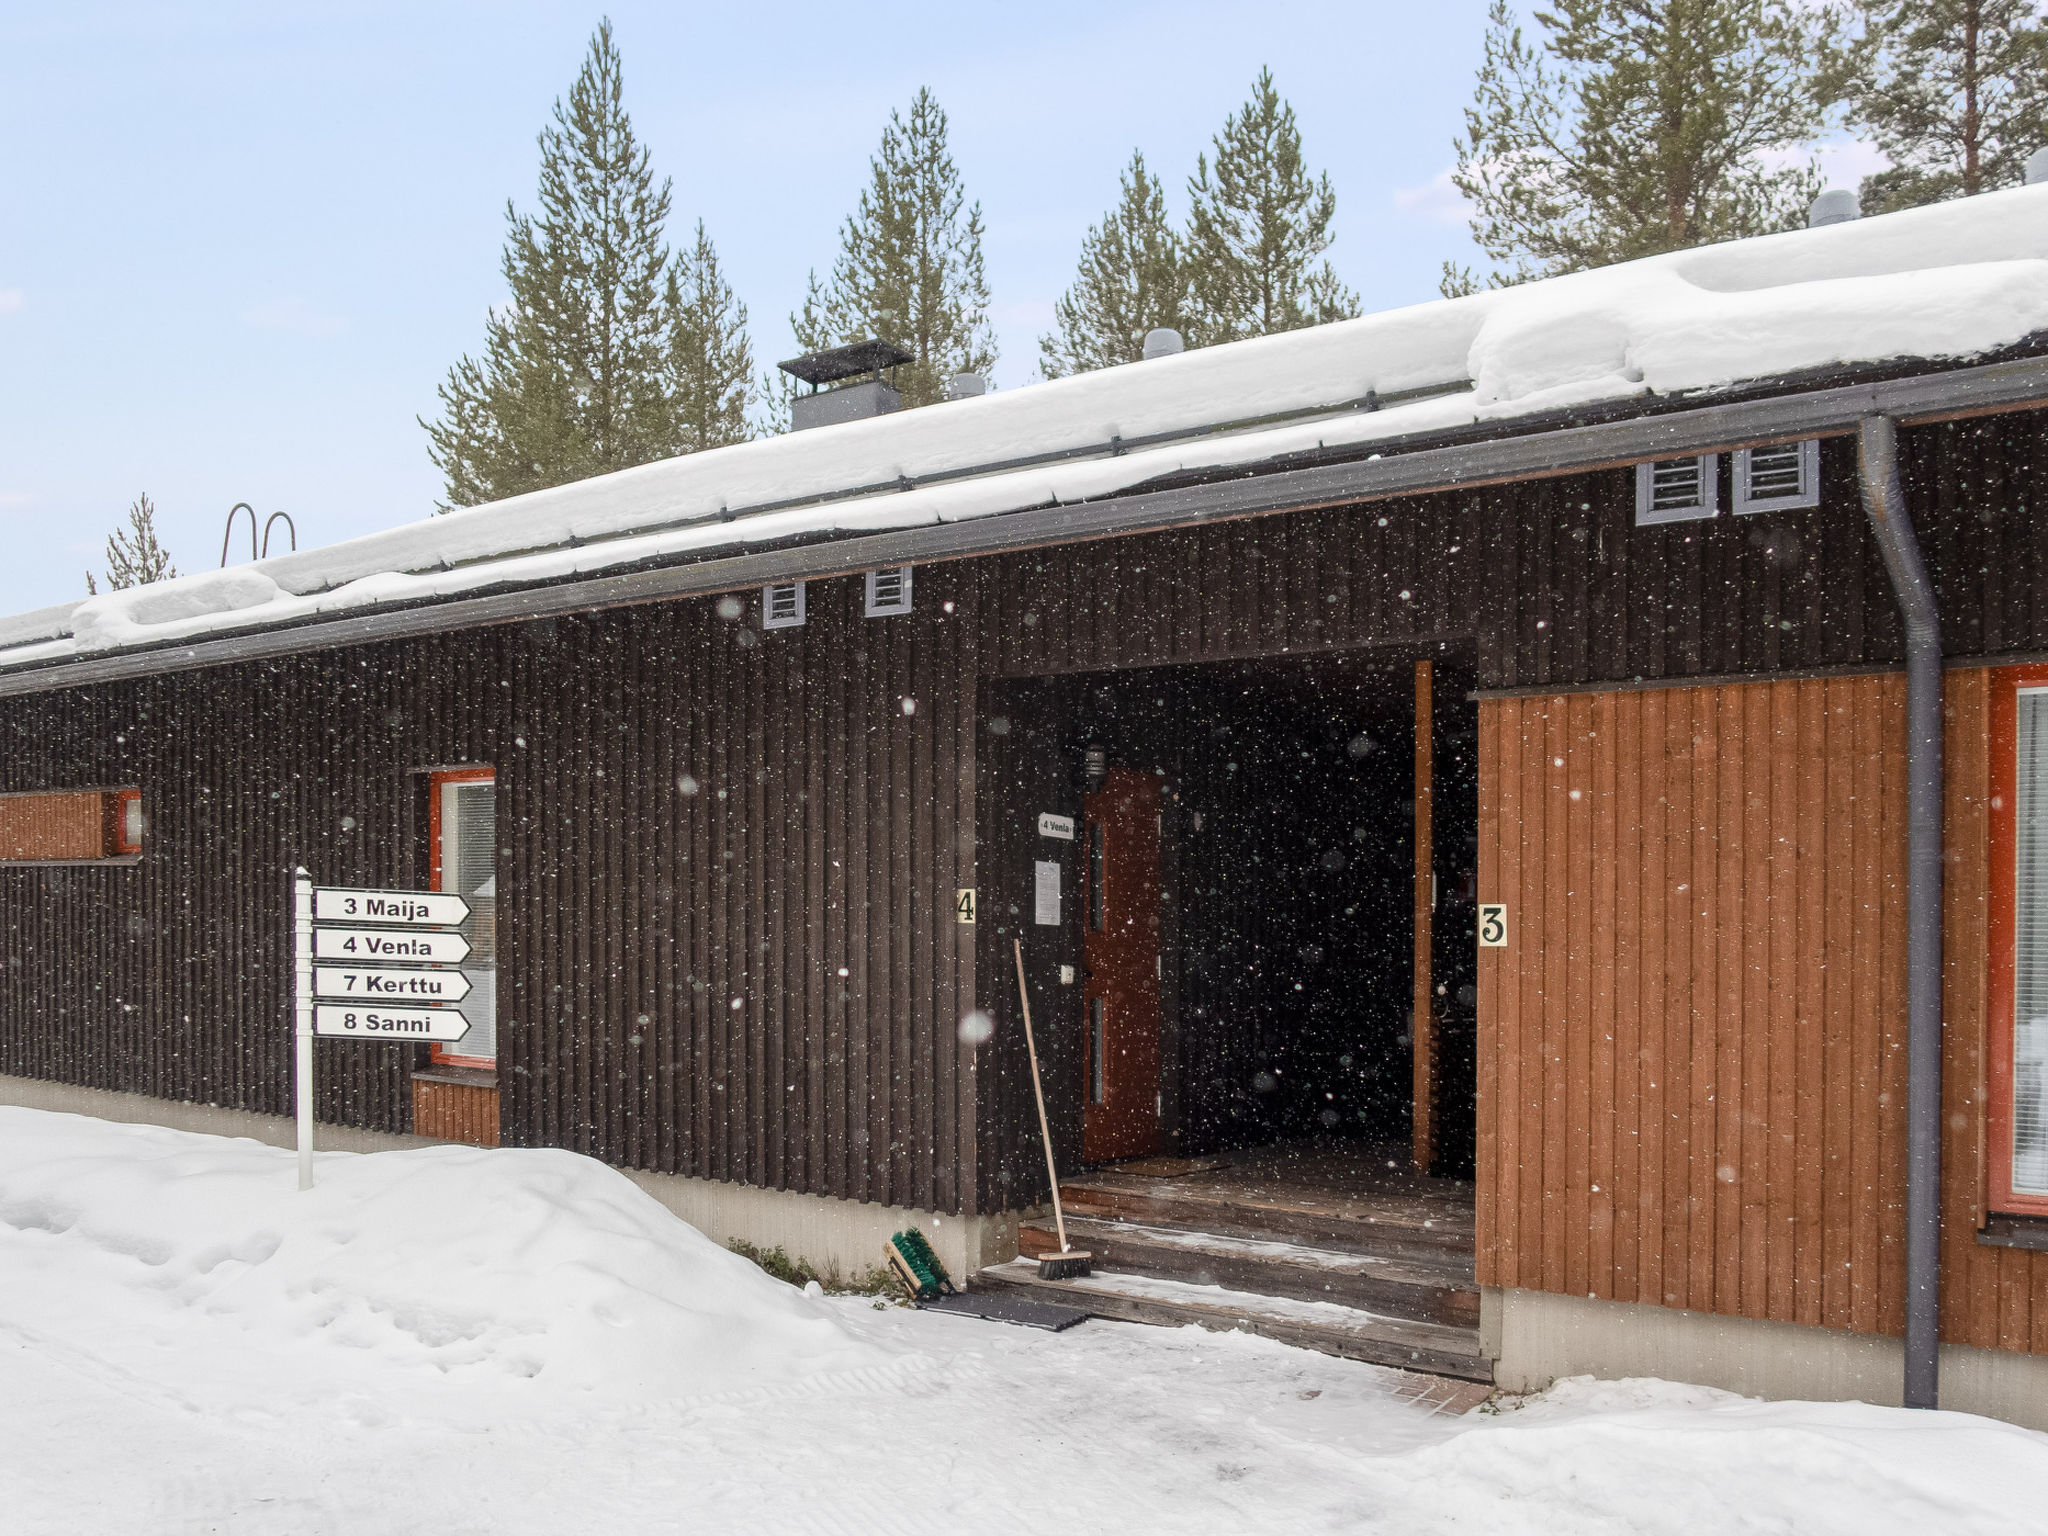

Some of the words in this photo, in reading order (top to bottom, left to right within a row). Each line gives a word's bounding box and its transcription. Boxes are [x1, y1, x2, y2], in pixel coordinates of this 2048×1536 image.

[1043, 820, 1049, 830] 4
[1049, 821, 1070, 833] Venla
[343, 898, 357, 915] 3
[366, 899, 430, 921] Maija
[958, 891, 974, 921] 4
[1482, 907, 1504, 943] 3
[343, 936, 357, 953] 4
[366, 937, 432, 956] Venla
[343, 975, 357, 991] 7
[366, 976, 442, 995] Kerttu
[344, 1013, 357, 1030] 8
[366, 1014, 431, 1033] Sanni
